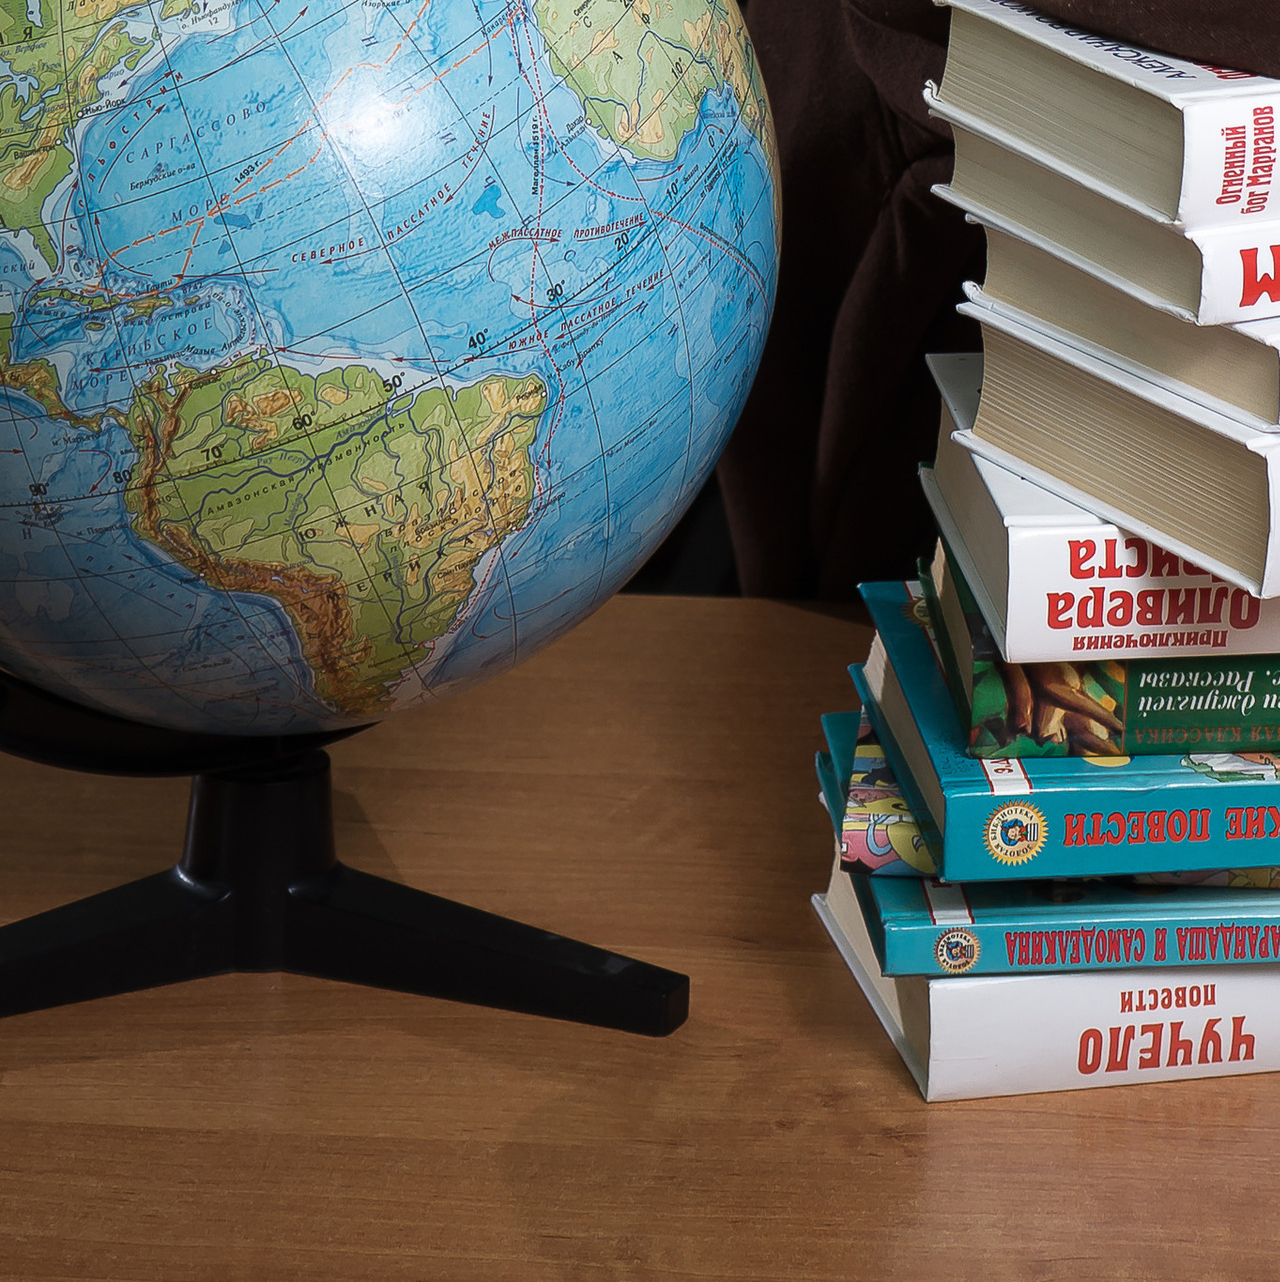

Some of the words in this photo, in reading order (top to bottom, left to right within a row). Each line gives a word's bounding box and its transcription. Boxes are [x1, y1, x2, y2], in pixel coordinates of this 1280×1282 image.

[208, 16, 220, 28] 12
[84, 97, 127, 117] Нью-Йорк
[125, 99, 268, 165] САРГАССОВО
[1246, 105, 1277, 189] Марранов
[234, 165, 254, 185] 1493
[1215, 124, 1246, 206] Огненный
[291, 237, 365, 264] СЕВЕРНОЕ
[386, 182, 452, 241] ПАССАТНОЕ
[461, 111, 492, 170] ТЕЧЕНИЕ
[171, 192, 229, 224] МОРЕ
[1240, 189, 1266, 215] бог
[573, 212, 645, 239] ПРОТИВОТЕЧЕНИЕ
[614, 230, 631, 252] 20°
[546, 279, 567, 303] 30°
[560, 296, 617, 332] ПАССАТНОЕ
[625, 268, 665, 298] ТЕЧЕНИЕ
[85, 317, 214, 366] КАРИБСКОЕ
[466, 328, 489, 350] 40°
[71, 371, 129, 390] МОРЕ
[382, 371, 406, 393] 50°
[292, 410, 317, 431] 60°
[200, 444, 225, 463] 70°
[112, 467, 136, 485] 80°
[206, 476, 296, 516] Амазонская
[307, 422, 406, 475] низменность
[28, 482, 51, 497] 90°
[299, 480, 430, 542] ЮЖНАЯ
[1046, 586, 1261, 631] Оливера
[1071, 629, 1229, 651] Приключения
[1138, 669, 1256, 693] Рассказы
[1138, 690, 1257, 719] джунглей
[1134, 725, 1244, 745] КЛАССИКА
[1062, 807, 1212, 848] ПОВЕСТИ
[1004, 925, 1146, 966] САМОДЕЛКИНА
[1153, 928, 1168, 962] И
[1076, 1015, 1256, 1076] ЧУЧЕЛО
